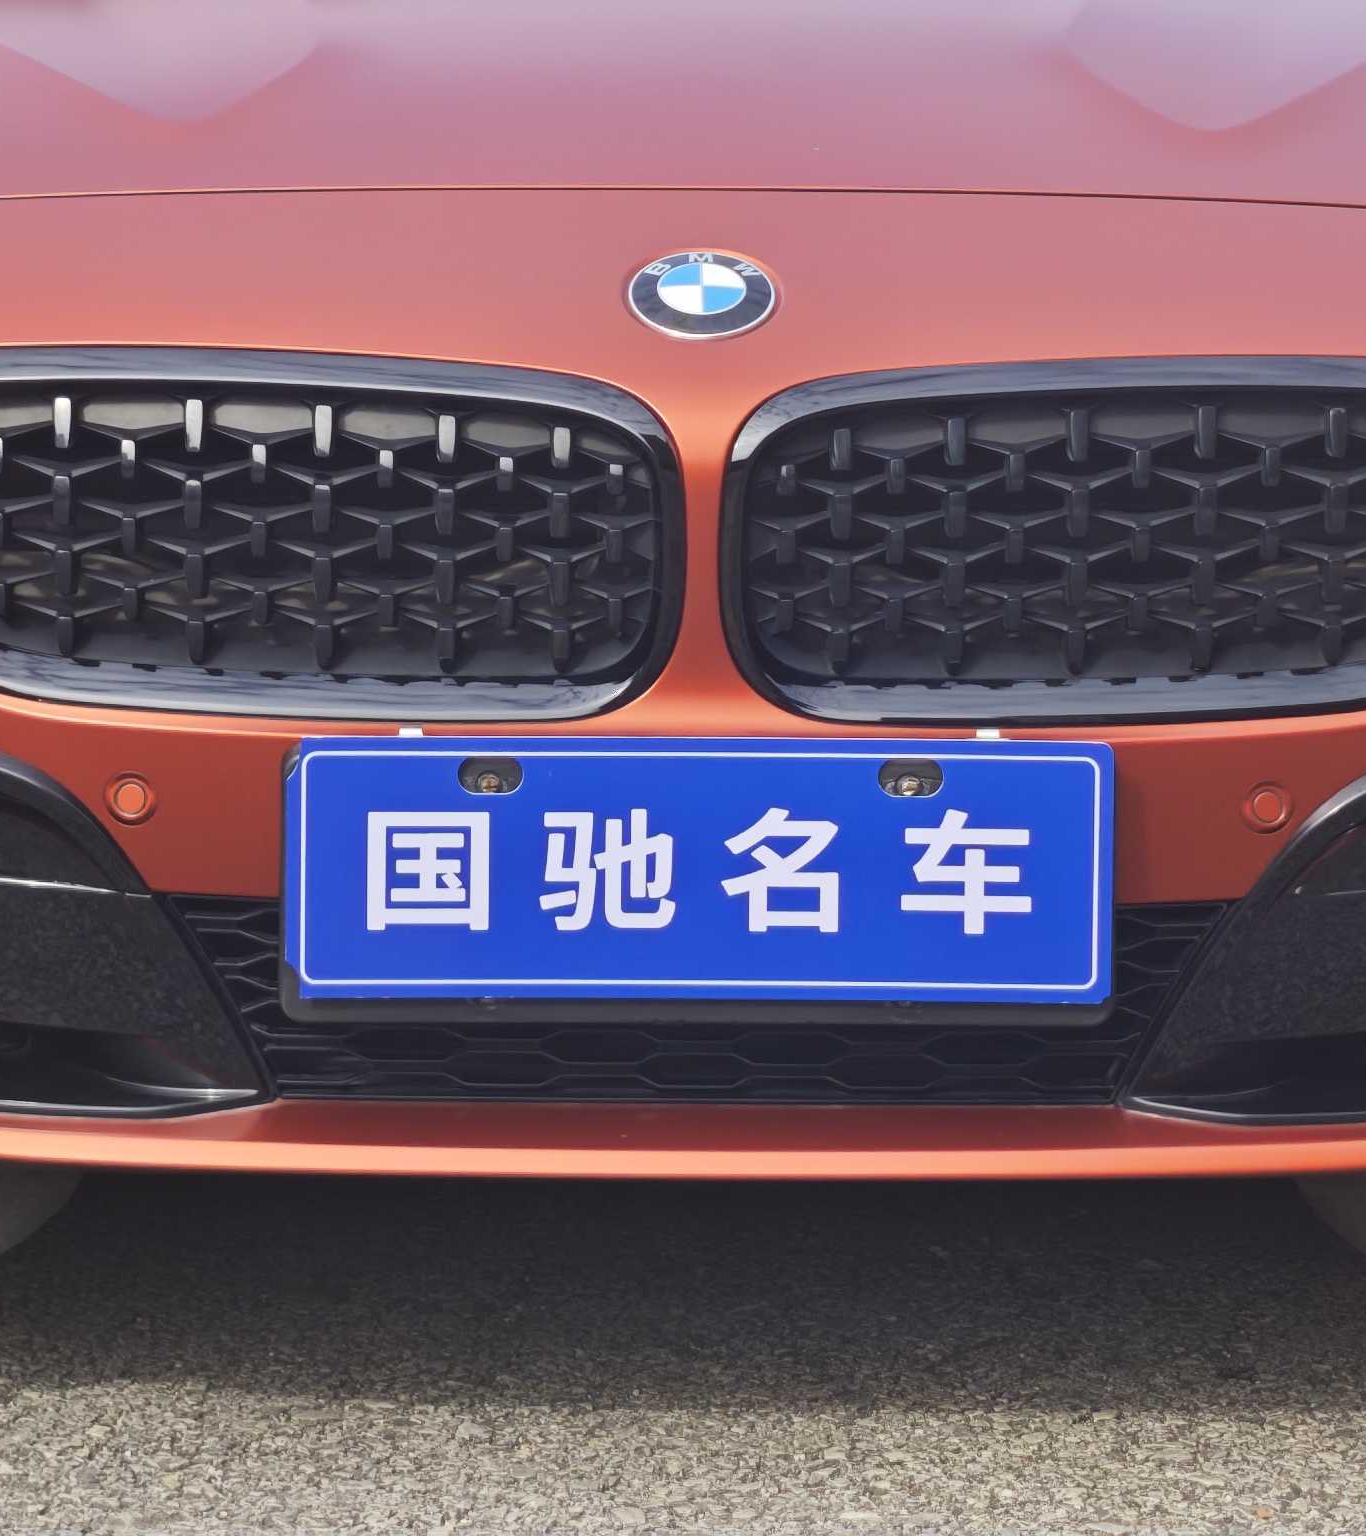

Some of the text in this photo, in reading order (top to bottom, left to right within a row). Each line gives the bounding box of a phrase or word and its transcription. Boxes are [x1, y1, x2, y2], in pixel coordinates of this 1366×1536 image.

[643, 252, 762, 277] BMW
[366, 807, 1033, 935] 国驰名车
